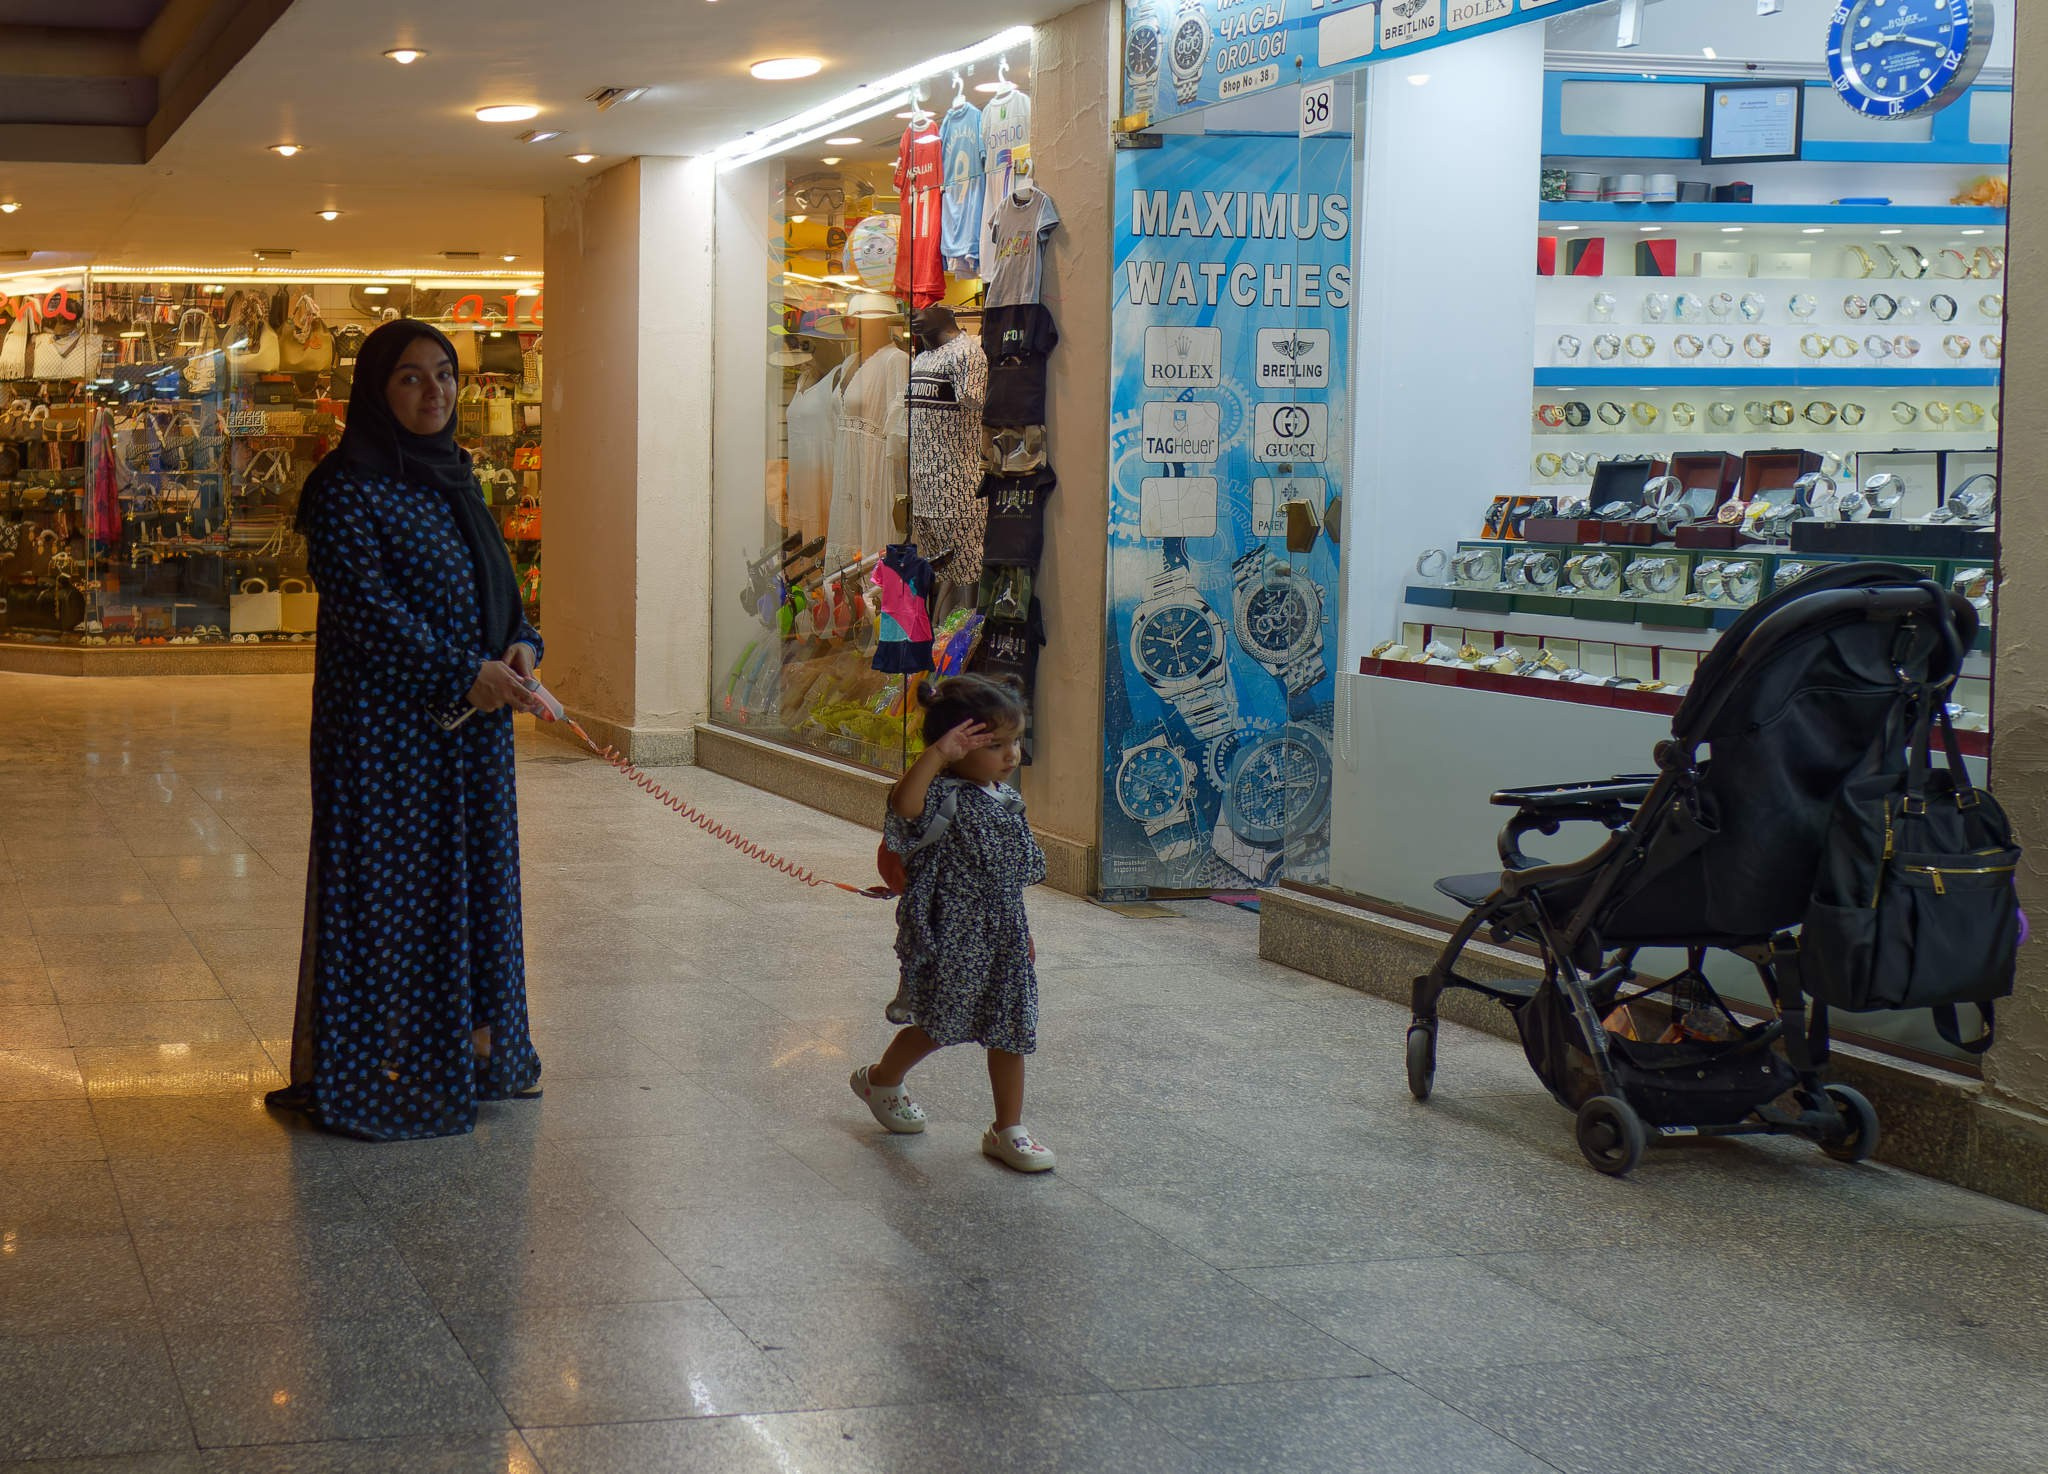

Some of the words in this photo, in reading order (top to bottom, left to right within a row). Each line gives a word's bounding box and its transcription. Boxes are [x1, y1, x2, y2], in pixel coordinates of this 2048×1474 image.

[1220, 0, 1286, 41] ЧАСЫ
[1453, 0, 1506, 22] ROLEX
[1385, 16, 1435, 39] BREITLING
[1216, 29, 1288, 73] OROLOGI
[1223, 81, 1240, 93] Shop
[1260, 69, 1269, 82] 38
[1304, 92, 1329, 125] 38
[1131, 189, 1349, 241] MAXIMUS
[1126, 261, 1351, 308] WATCHES
[1151, 364, 1214, 379] ROLEX
[1262, 364, 1322, 378] BREITLING
[1265, 443, 1316, 458] GUCCI
